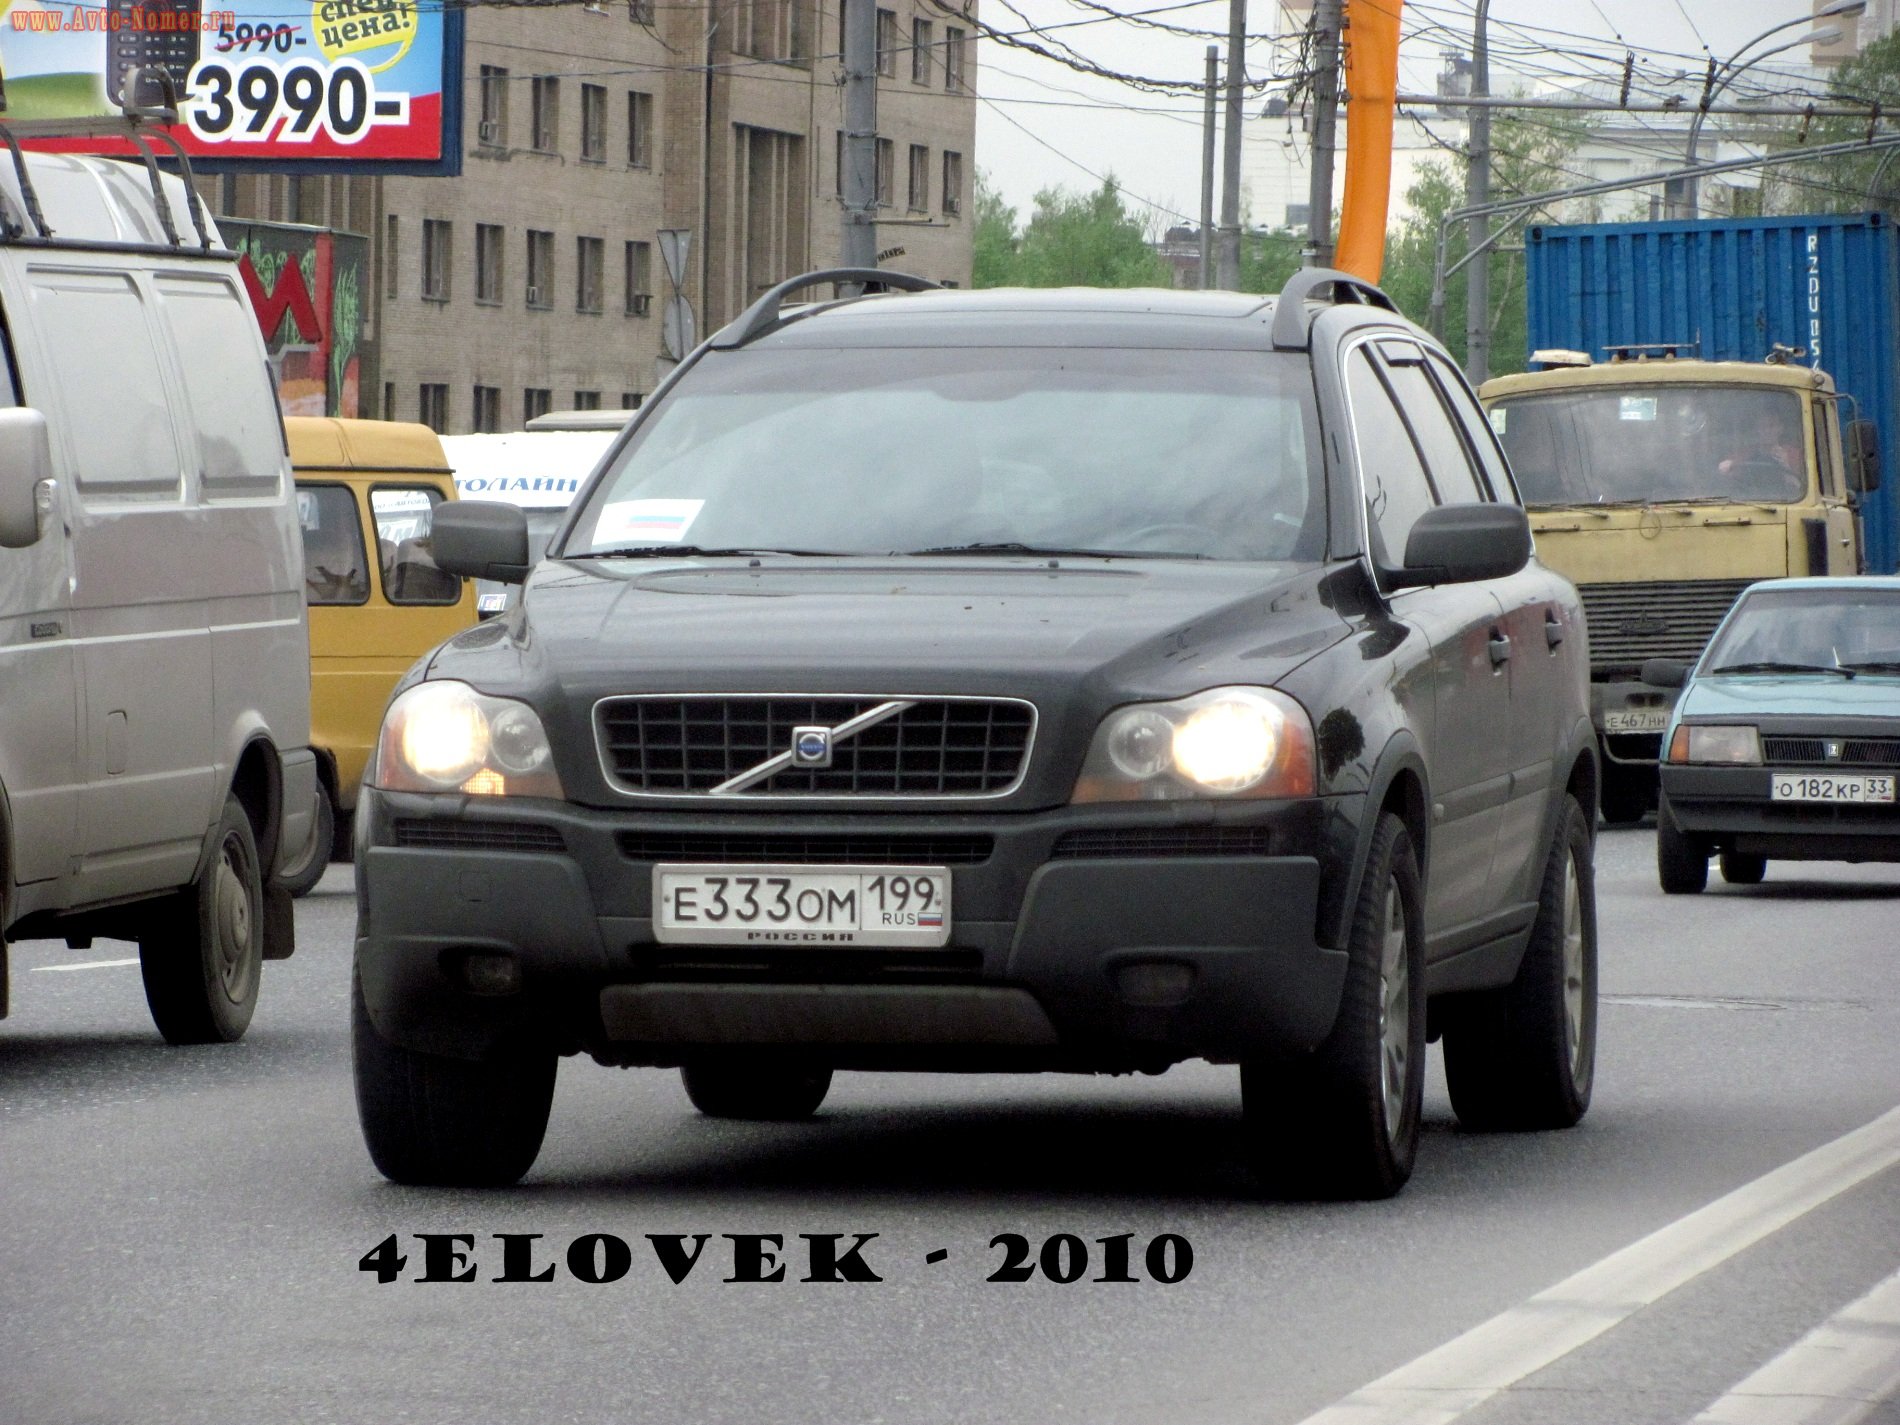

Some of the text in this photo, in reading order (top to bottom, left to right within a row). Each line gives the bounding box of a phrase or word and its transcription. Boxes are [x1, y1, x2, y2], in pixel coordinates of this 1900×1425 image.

[321, 5, 410, 48] цена!
[1807, 235, 1819, 312] RZDU
[1867, 779, 1887, 794] 33
[867, 876, 934, 911] 199
[882, 912, 916, 925] RUS
[747, 932, 853, 941] РОССИЯ
